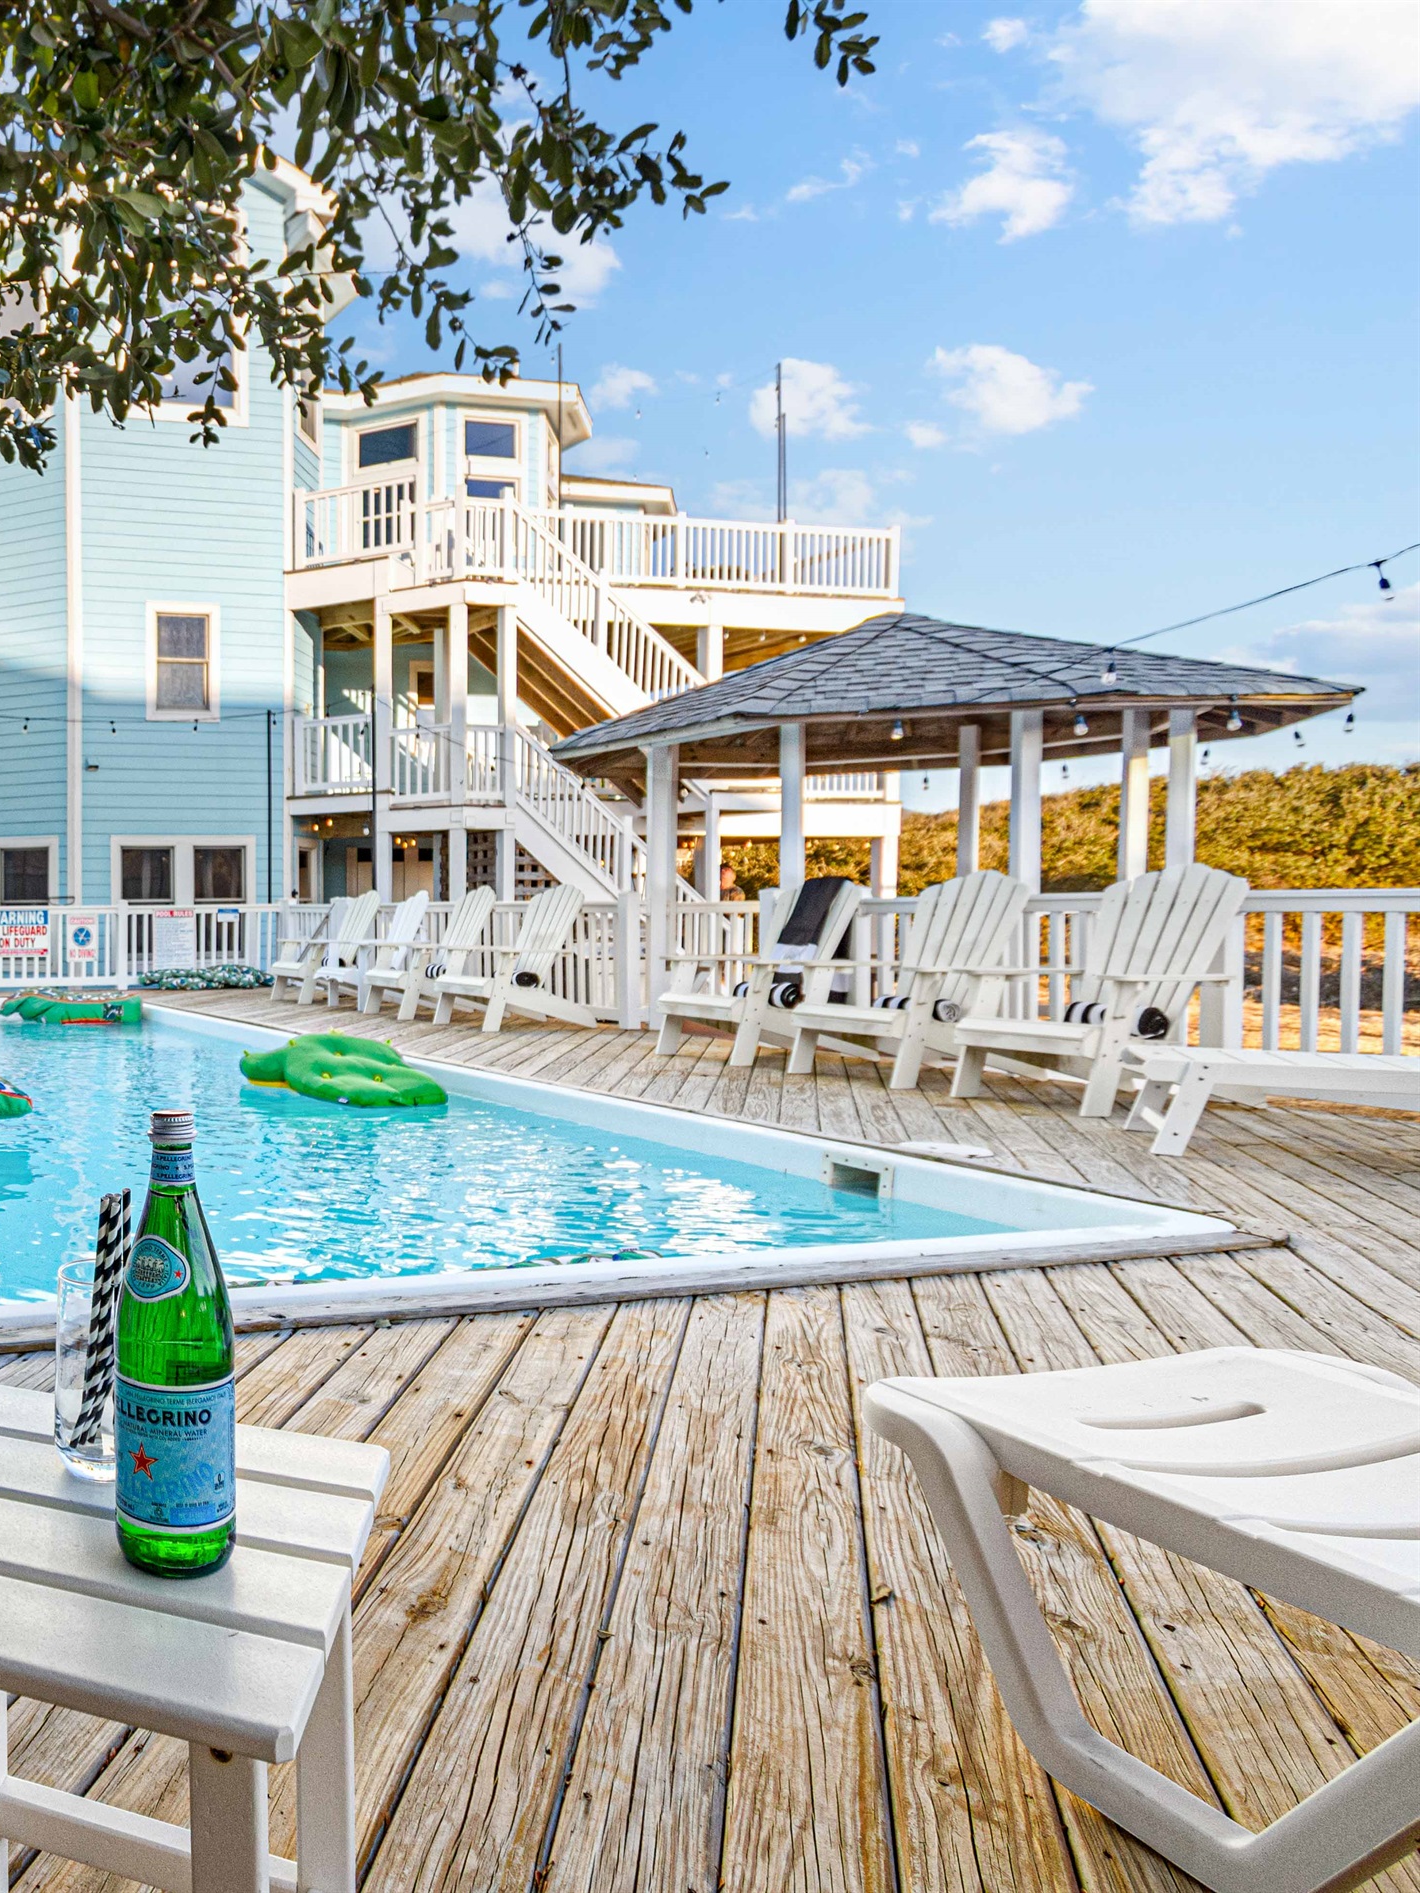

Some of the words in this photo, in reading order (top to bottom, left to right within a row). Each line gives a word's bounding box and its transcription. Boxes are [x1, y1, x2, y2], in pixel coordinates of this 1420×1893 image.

[2, 926, 47, 936] LIFEGUARD
[0, 938, 10, 948] ON
[14, 937, 36, 948] DUTY
[70, 949, 77, 958] NO
[78, 949, 95, 958] DIVING
[150, 1428, 181, 1437] MINERAL
[184, 1428, 208, 1438] WATER
